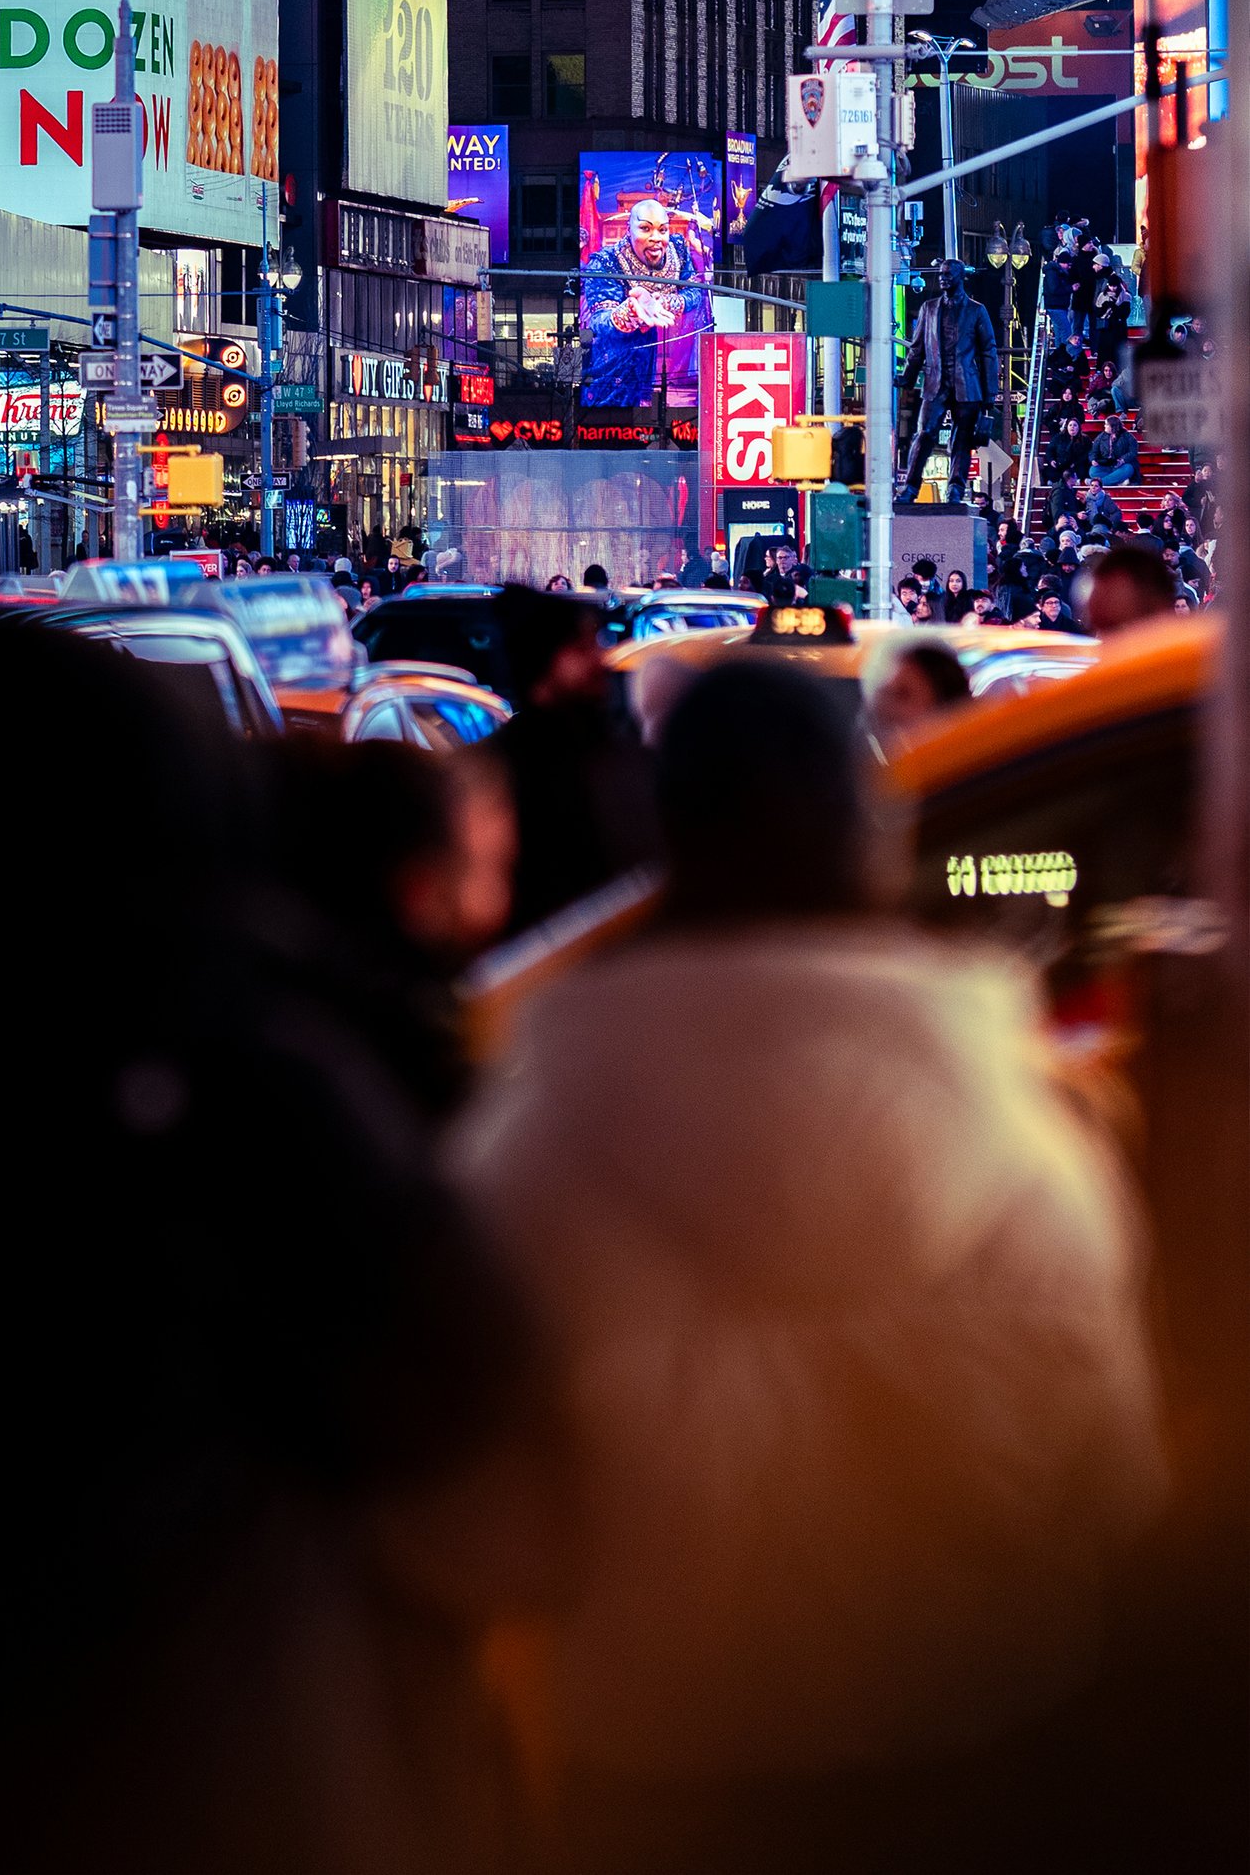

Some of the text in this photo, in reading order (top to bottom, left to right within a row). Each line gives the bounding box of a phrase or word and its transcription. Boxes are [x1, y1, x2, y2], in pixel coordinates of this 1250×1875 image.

[905, 36, 1078, 89] ost
[842, 110, 873, 123] 726161
[384, 100, 435, 151] YEARS
[448, 158, 500, 171] NTED!
[13, 331, 26, 346] St
[96, 365, 115, 379] ON
[283, 388, 290, 397] W
[294, 388, 304, 397] 47
[276, 400, 321, 409] Lloyd Richards
[727, 343, 790, 481] tkts
[514, 420, 562, 441] CVS
[578, 425, 654, 444] harmacy
[716, 418, 724, 463] development
[901, 553, 946, 563] GEORGE
